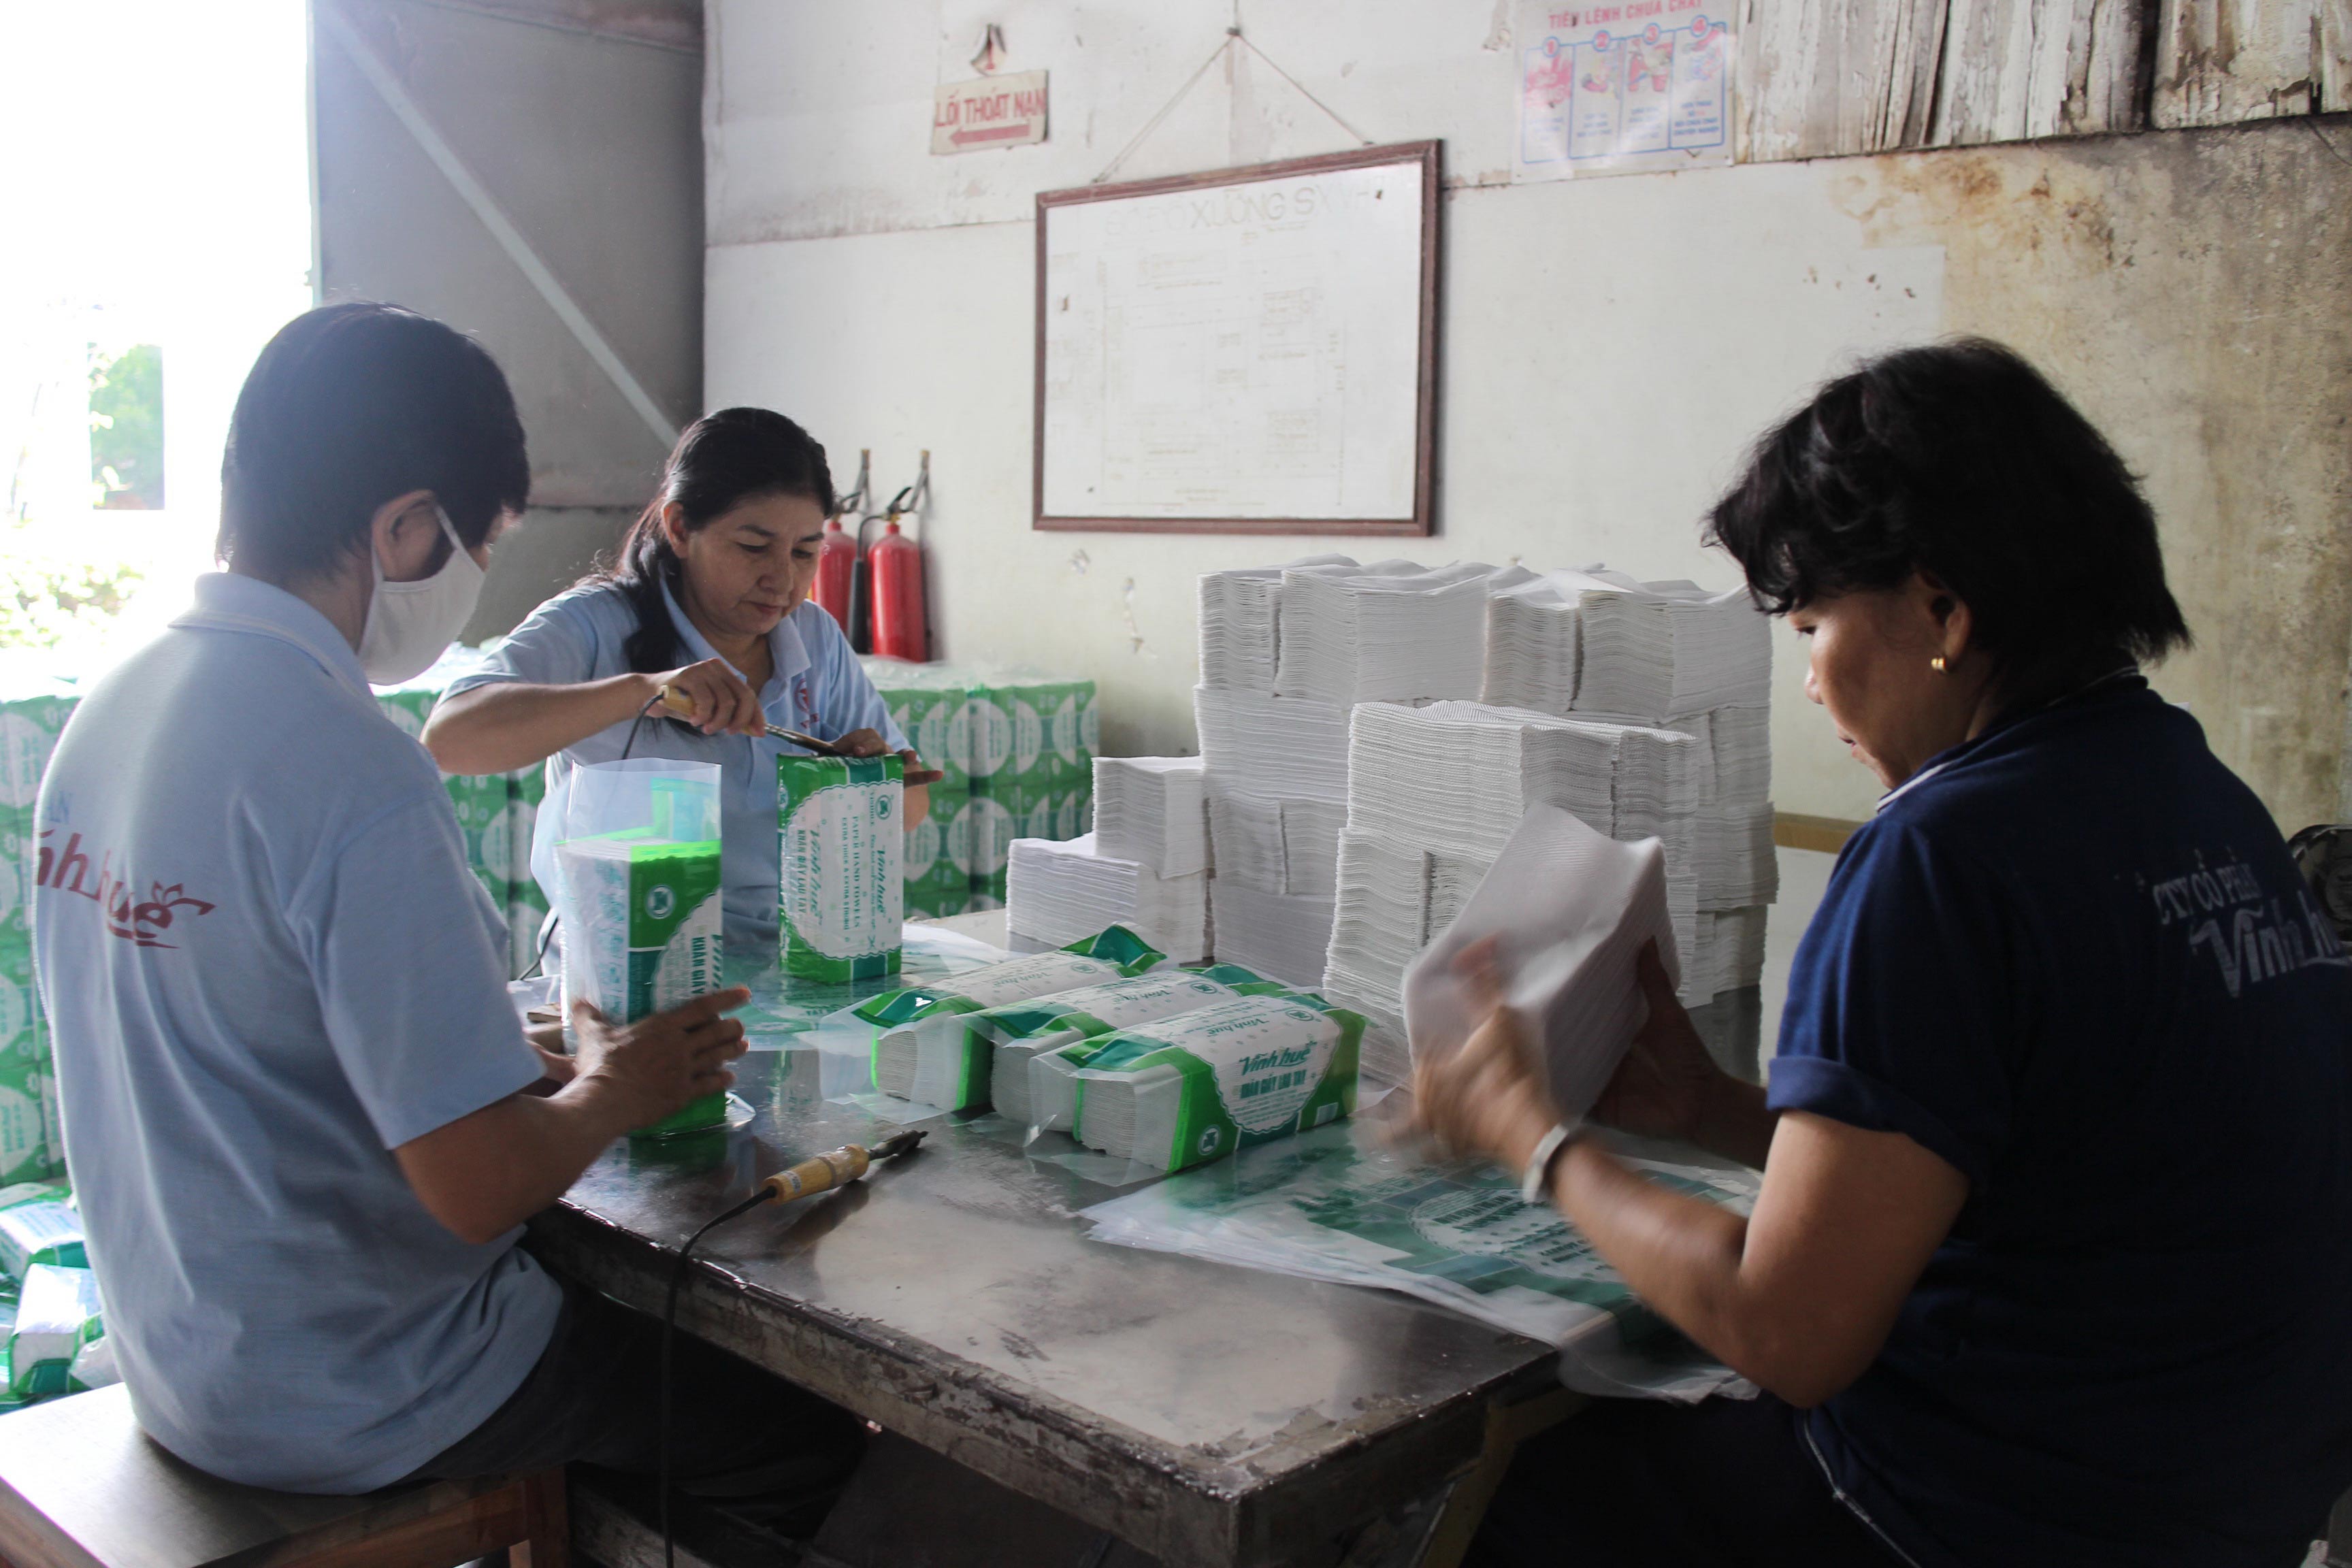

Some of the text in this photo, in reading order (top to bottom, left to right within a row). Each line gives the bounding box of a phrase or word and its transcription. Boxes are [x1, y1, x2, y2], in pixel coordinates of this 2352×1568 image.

[1694, 18, 1707, 33] 4
[1597, 33, 1608, 48] 2
[1647, 27, 1658, 42] 3
[1546, 39, 1556, 55] 1
[691, 936, 707, 967] KHĂN
[1239, 1050, 1278, 1076] Vĩnh
